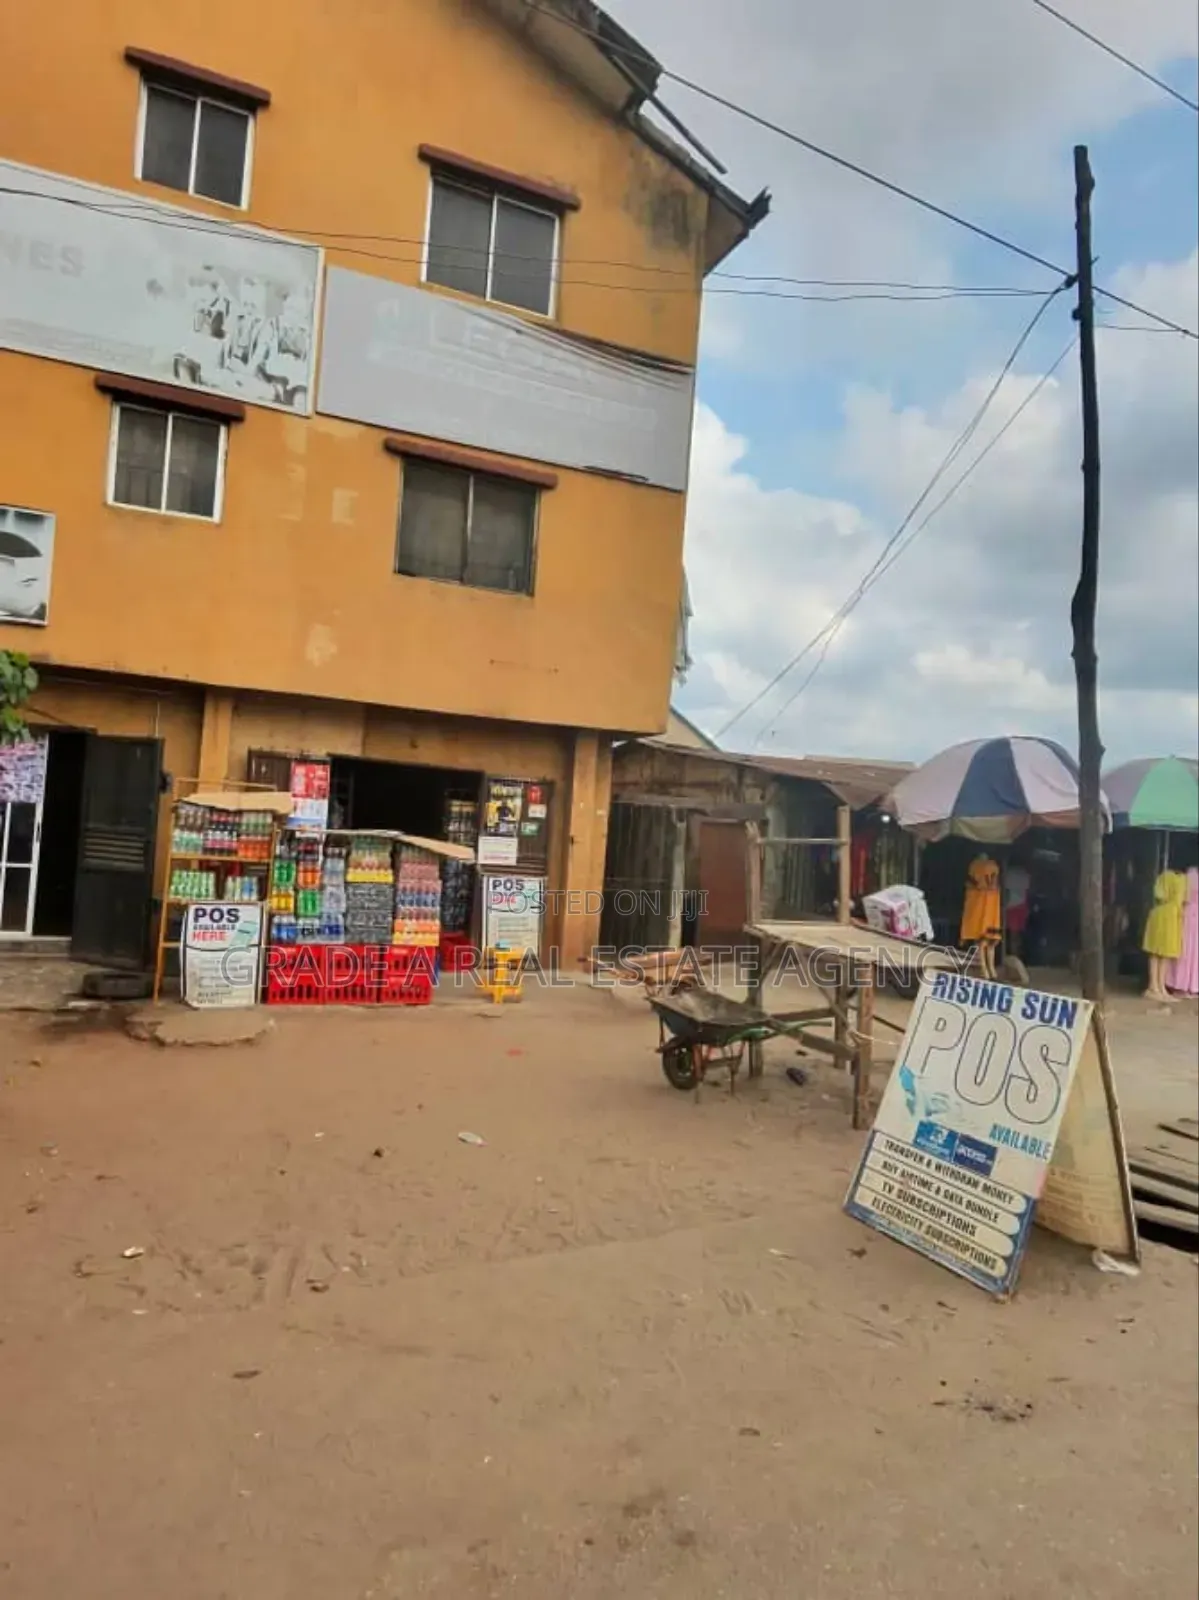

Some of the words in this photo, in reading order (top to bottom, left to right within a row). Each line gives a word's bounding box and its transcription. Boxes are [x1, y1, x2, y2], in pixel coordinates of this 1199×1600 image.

[492, 878, 525, 891] POS
[193, 907, 240, 923] POS
[193, 931, 226, 941] HERE
[932, 972, 1014, 1014] RISING
[1021, 992, 1077, 1029] SUN
[903, 996, 1072, 1124] POS
[989, 1123, 1053, 1160] AVAILABLE
[882, 1160, 899, 1175] BUY
[944, 1189, 963, 1207] DATA
[966, 1199, 999, 1223] BUNDLE
[885, 1139, 926, 1165] TRANSFER
[935, 1162, 980, 1190] WITHDRAW
[982, 1182, 1014, 1205] MONEY
[871, 1197, 923, 1230] ELECTRICITY
[924, 1222, 997, 1272] SUBSCRIPTIONS
[882, 1181, 895, 1194] TV
[896, 1188, 977, 1238] SUBSCRIPTIONS
